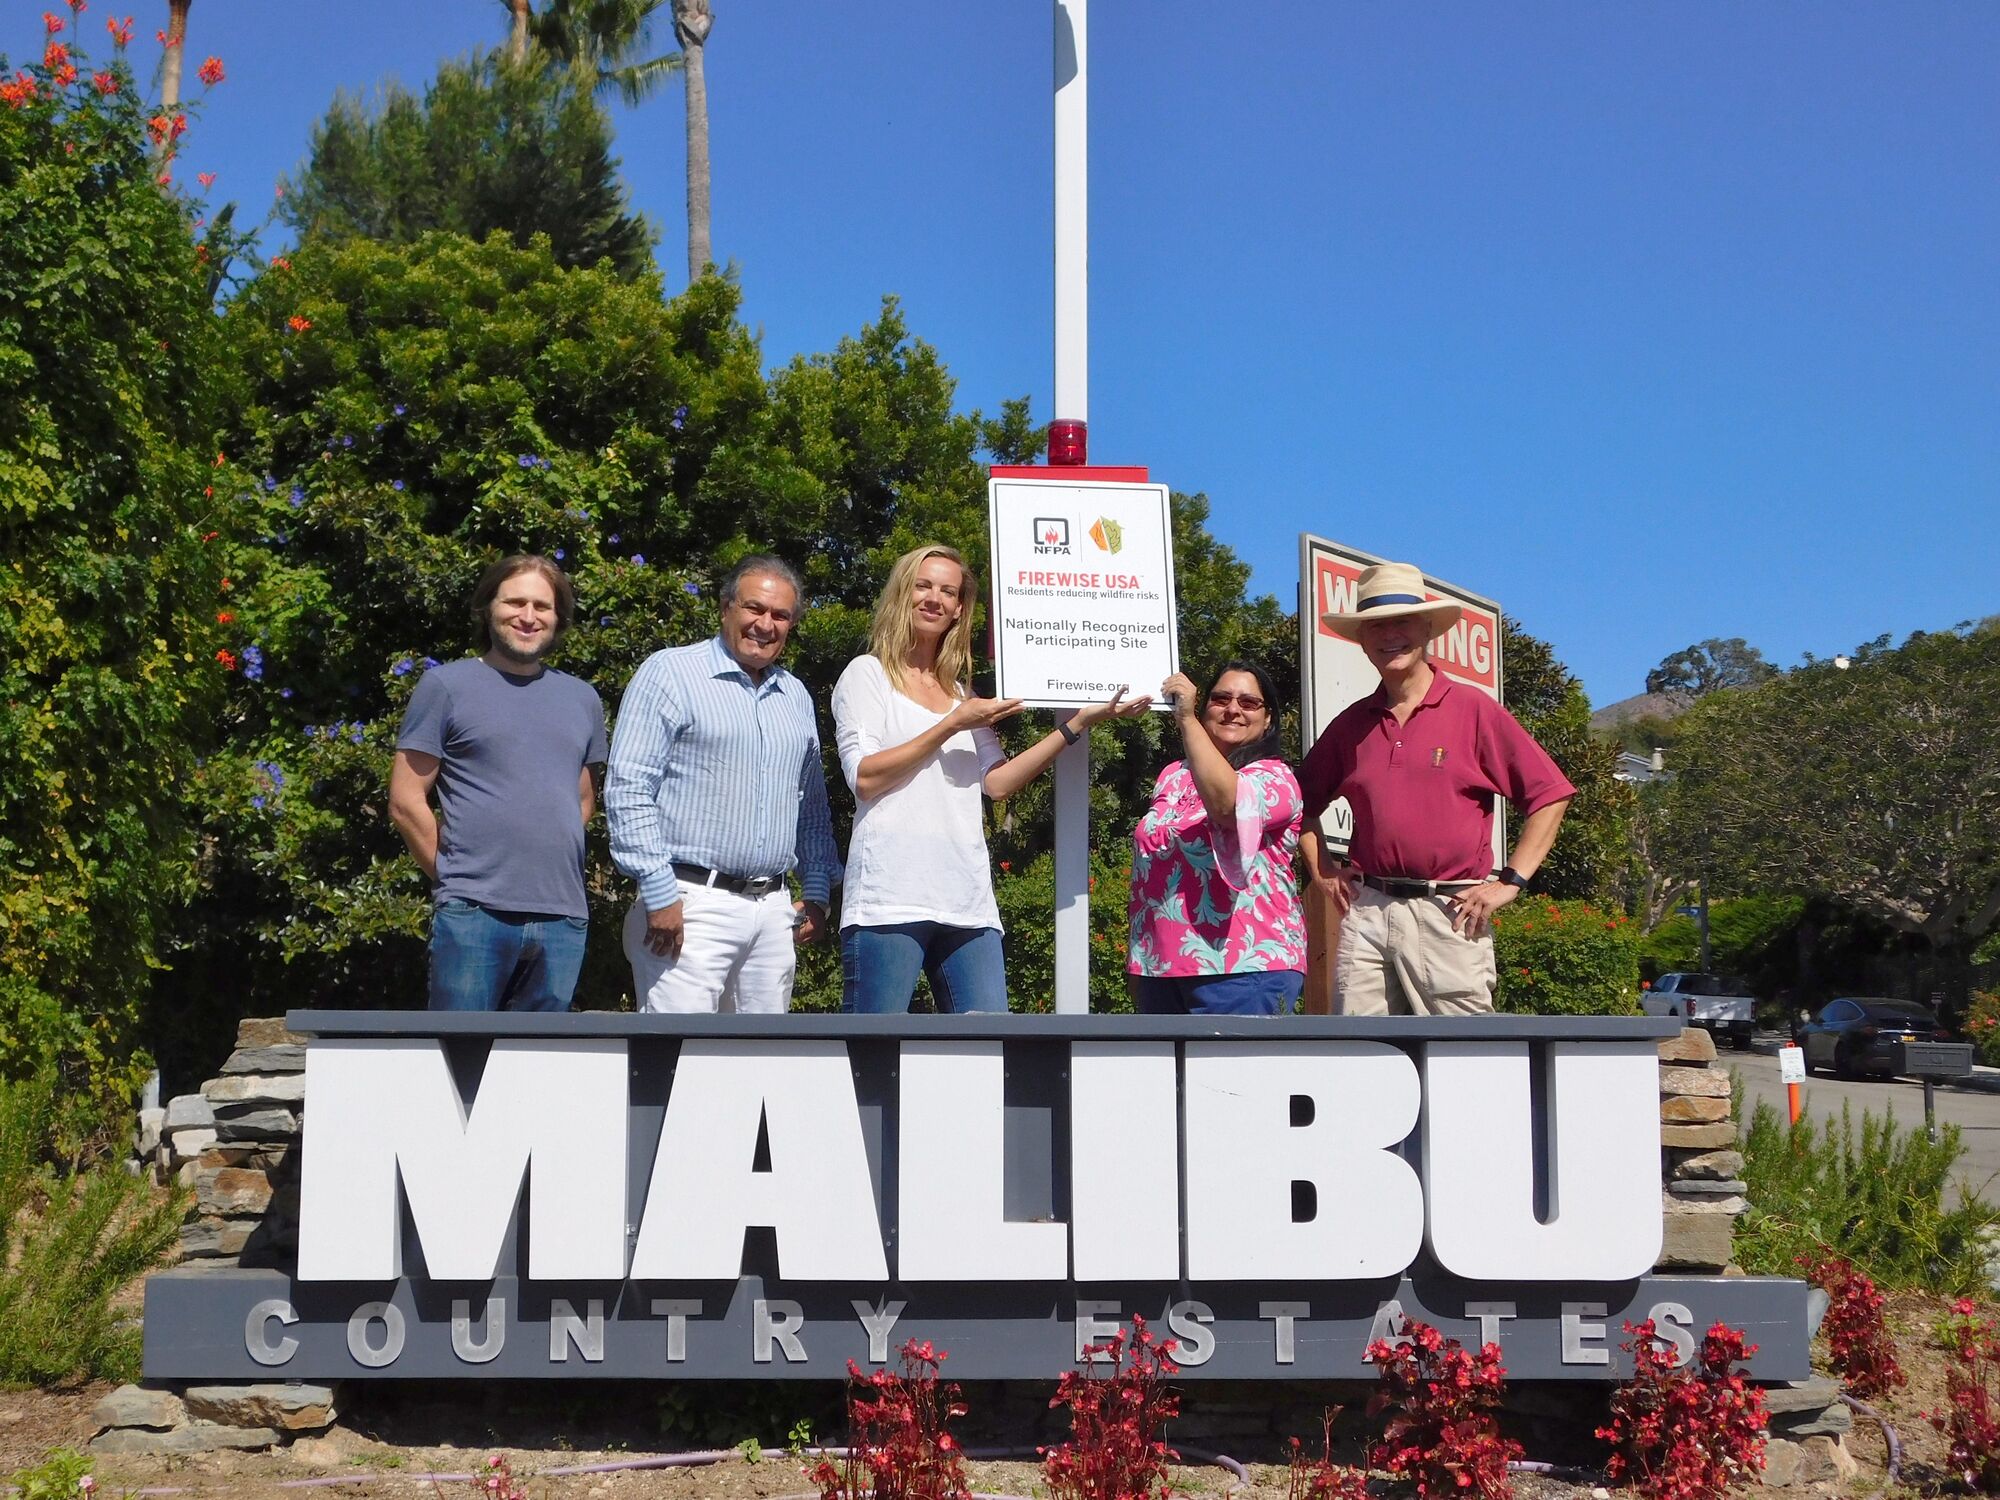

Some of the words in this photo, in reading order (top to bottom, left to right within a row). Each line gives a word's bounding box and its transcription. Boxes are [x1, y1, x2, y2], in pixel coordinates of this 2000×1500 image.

[1034, 546, 1071, 555] NFPA
[1018, 571, 1100, 588] FIREWISE
[1105, 574, 1140, 589] USA
[1007, 586, 1054, 597] Residents
[1056, 588, 1098, 600] reducing
[1100, 590, 1134, 600] wildfire
[1137, 591, 1159, 600] risks
[1006, 618, 1077, 633] Nationally
[1082, 621, 1166, 636] Recognized
[1323, 570, 1490, 674] WING
[1025, 634, 1116, 650] Participating
[1120, 637, 1148, 649] Site
[1047, 679, 1129, 694] Firewise.org
[296, 1038, 1664, 1283] MALIBU
[244, 1298, 908, 1368] COUNTRY
[1074, 1299, 1696, 1368] ESTATES
